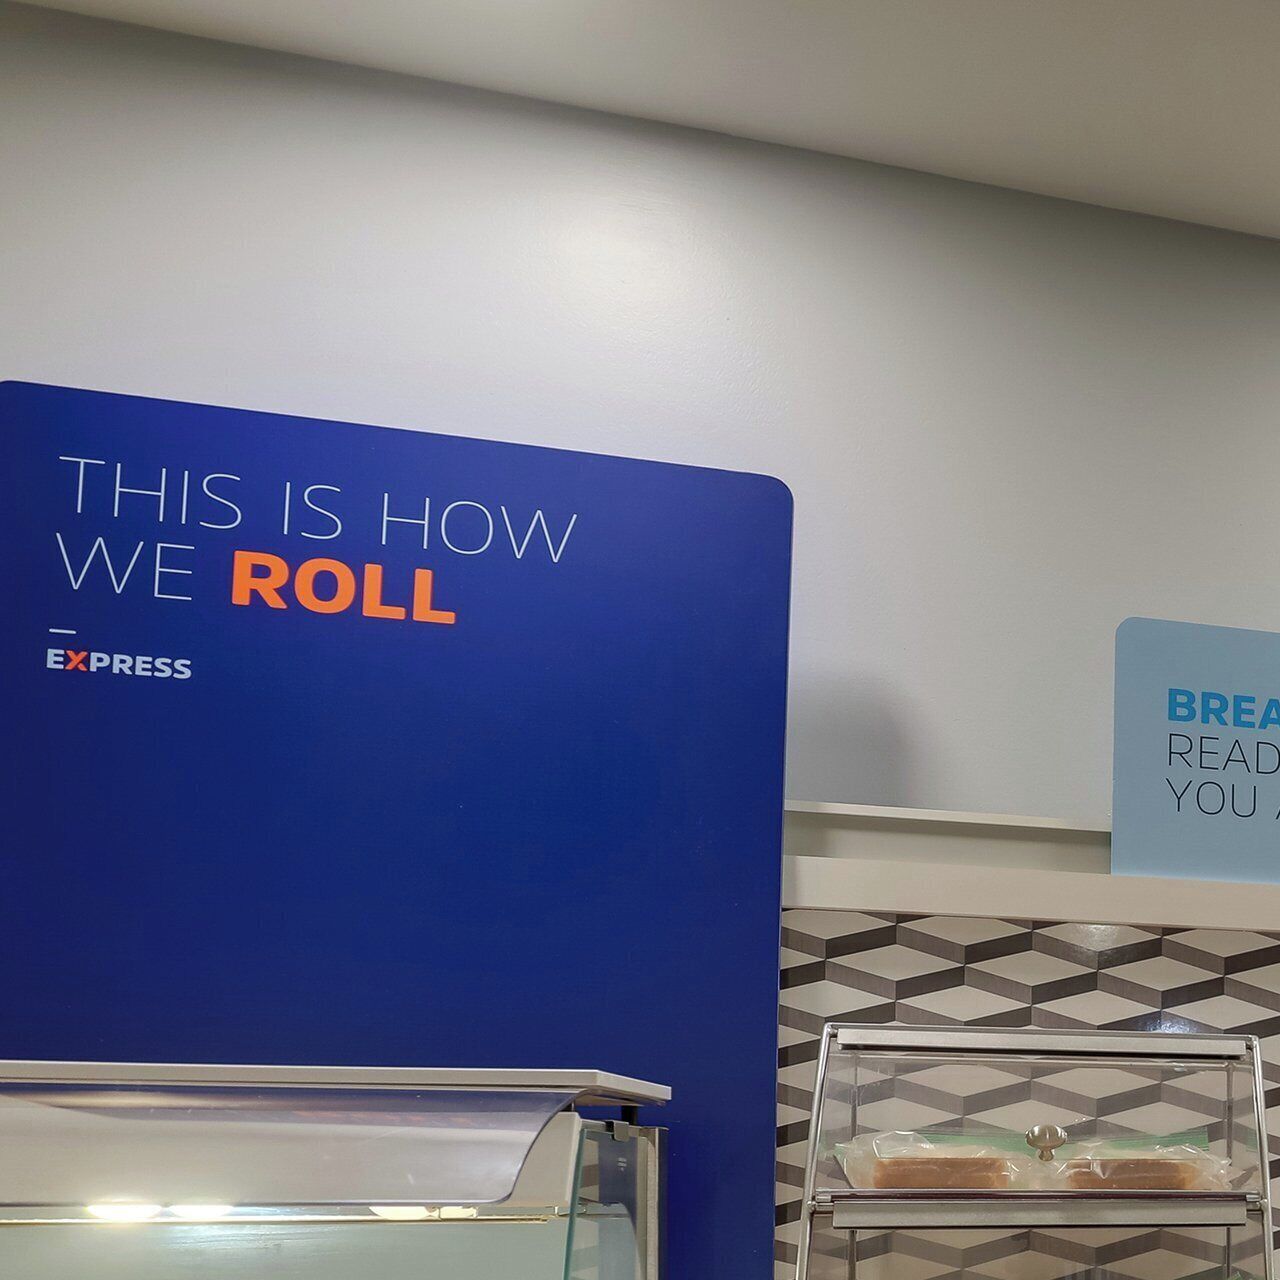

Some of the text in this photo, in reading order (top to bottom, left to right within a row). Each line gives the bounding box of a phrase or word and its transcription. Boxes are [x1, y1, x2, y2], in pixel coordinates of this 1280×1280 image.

[58, 455, 578, 564] THIS IS HOW
[55, 532, 457, 625] WE ROLL
[45, 647, 193, 681] EXPRESS
[1165, 777, 1258, 819] YOU
